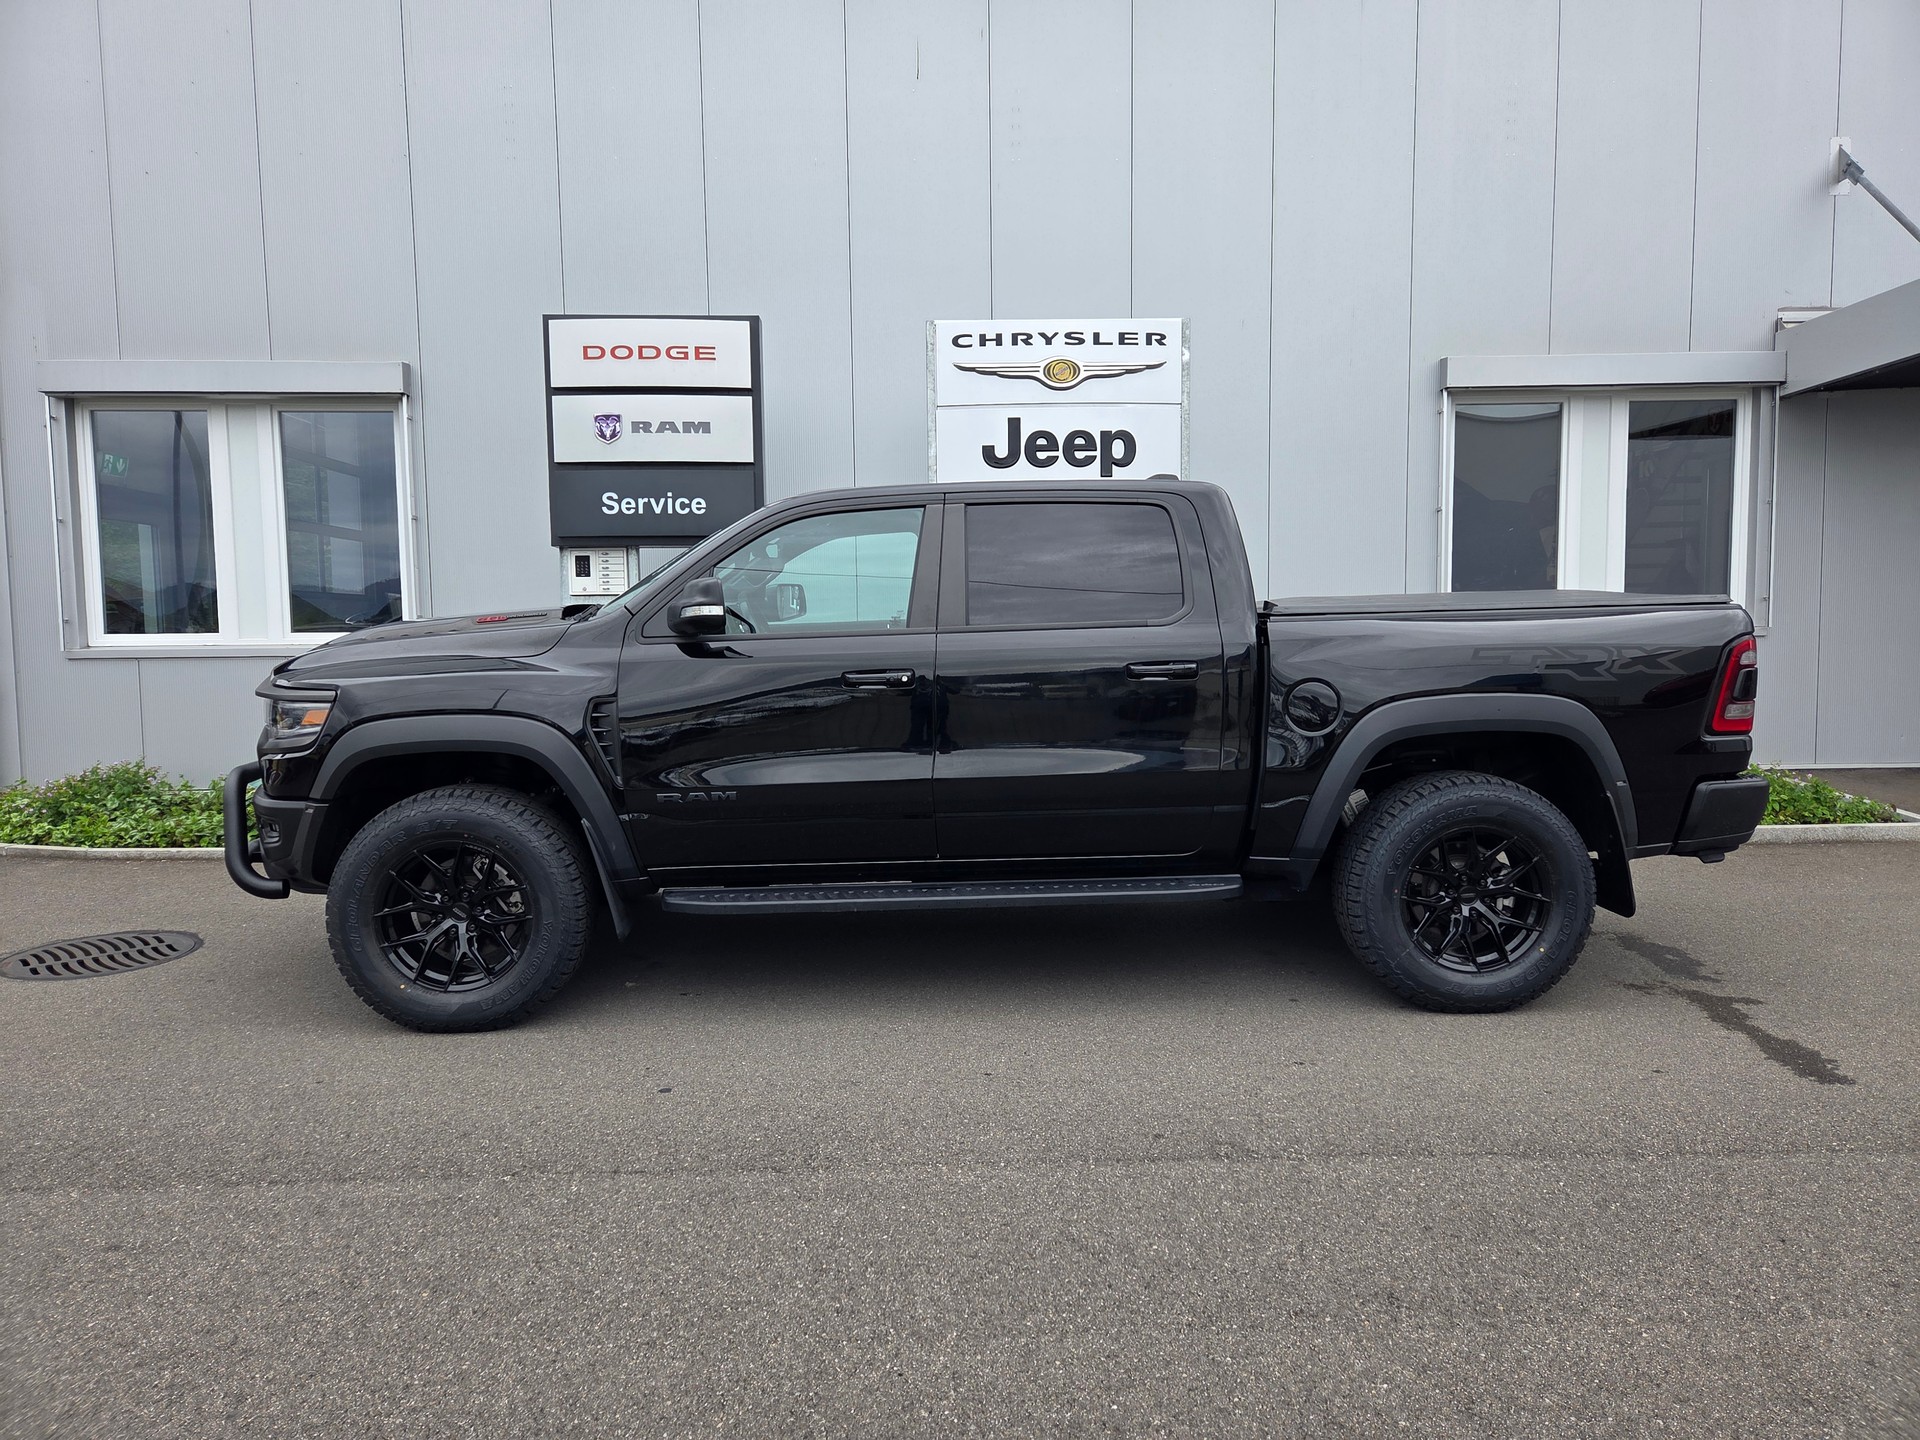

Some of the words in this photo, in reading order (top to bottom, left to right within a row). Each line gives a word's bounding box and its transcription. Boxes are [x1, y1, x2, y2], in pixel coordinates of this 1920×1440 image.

[582, 345, 717, 361] DODGE
[951, 331, 1167, 348] CHRYSLER
[630, 420, 712, 434] RAM
[981, 416, 1137, 478] Jeep
[601, 491, 707, 515] Service
[1470, 645, 1705, 682] TRX
[656, 791, 737, 803] RAM
[1387, 804, 1478, 876] YOKOHAMA
[347, 830, 407, 952] GEOLANDAR
[416, 819, 459, 835] A/T
[1496, 890, 1577, 993] GEOLANDAR
[479, 919, 553, 1010] YOKOHAMA
